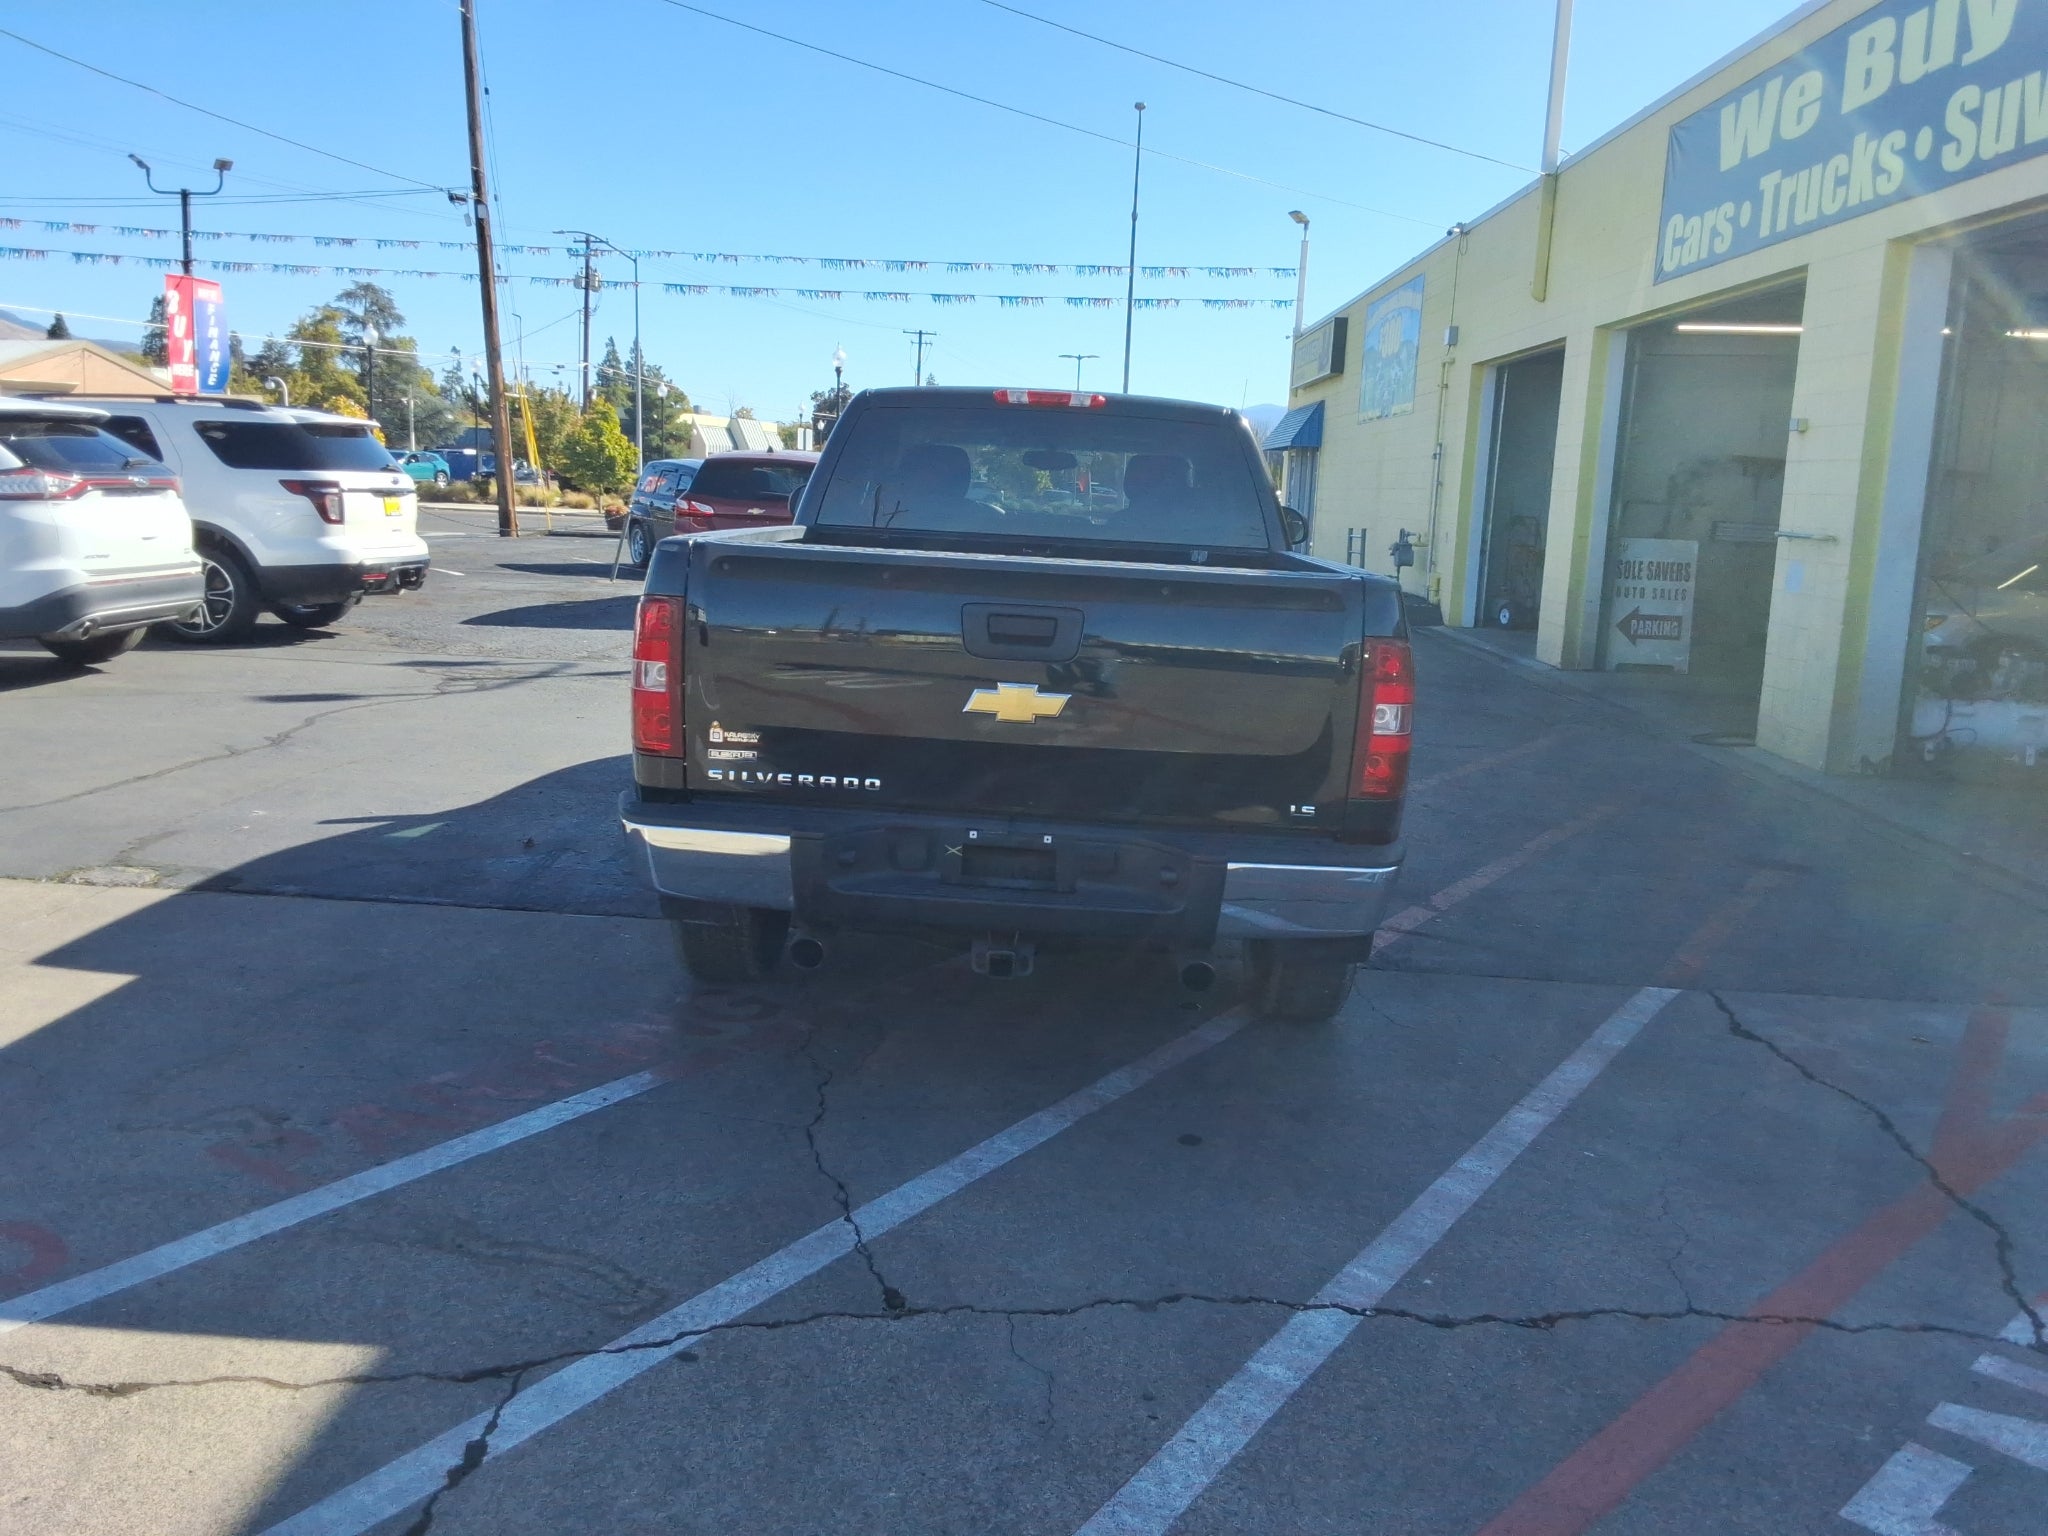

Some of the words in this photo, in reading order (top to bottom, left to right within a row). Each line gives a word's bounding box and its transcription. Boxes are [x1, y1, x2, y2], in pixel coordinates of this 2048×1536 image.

[1719, 70, 1823, 172] We
[1841, 0, 2018, 114] Buy
[1662, 200, 1735, 273] Cars
[1759, 129, 1907, 238] Trucks
[1616, 559, 1644, 580] SOLE
[1647, 560, 1692, 582] SAVERS
[1616, 586, 1646, 599] AUTO
[1651, 587, 1688, 601] SALES
[1630, 619, 1680, 636] PARKING
[708, 769, 881, 791] SILVERADO
